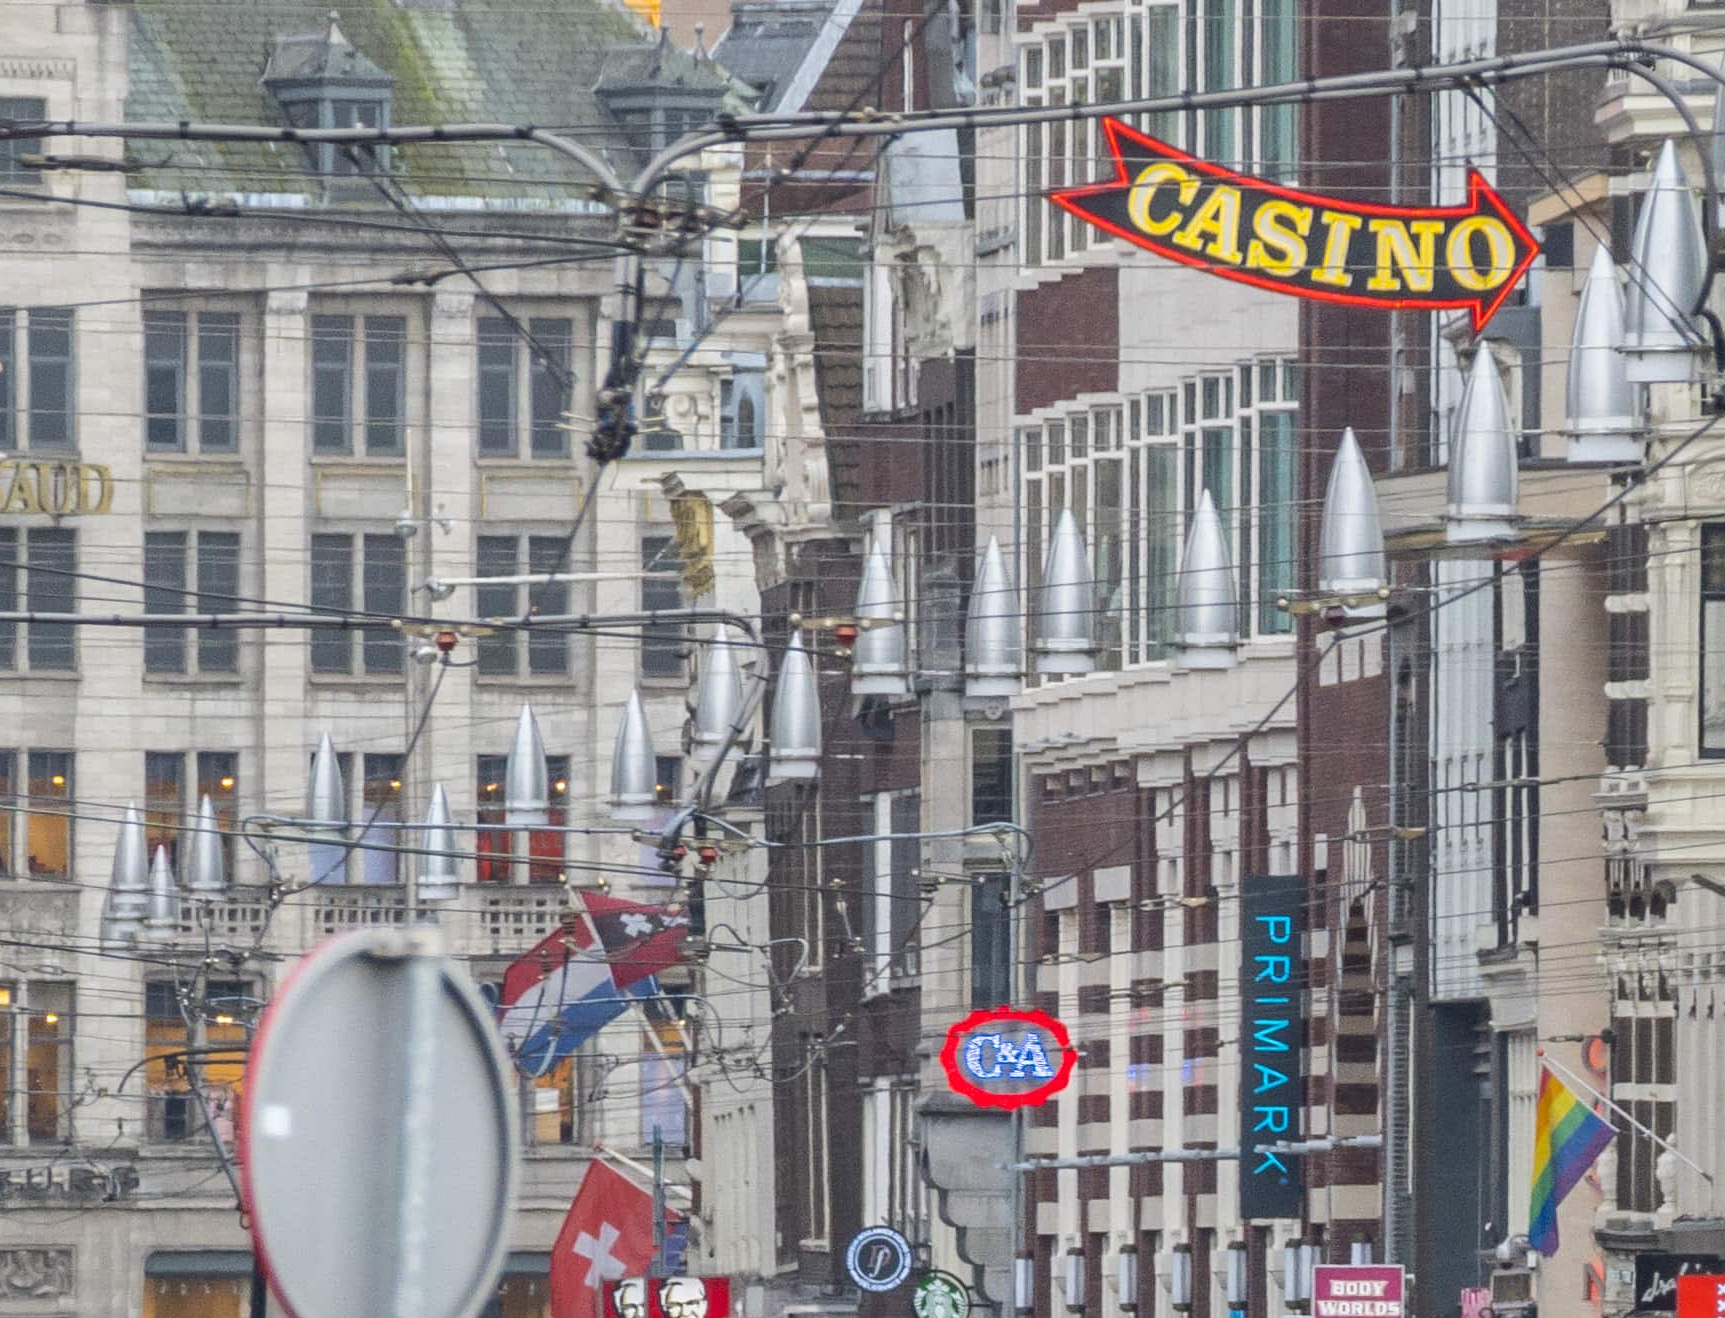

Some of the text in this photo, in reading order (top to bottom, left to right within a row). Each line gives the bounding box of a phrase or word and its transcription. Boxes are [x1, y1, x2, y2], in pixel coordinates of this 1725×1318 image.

[1127, 161, 1517, 293] CASINO
[964, 1032, 1055, 1080] C&A
[1252, 915, 1291, 1176] PRIMARK
[1317, 1301, 1400, 1317] WORLDS
[1329, 1280, 1389, 1297] BODY
